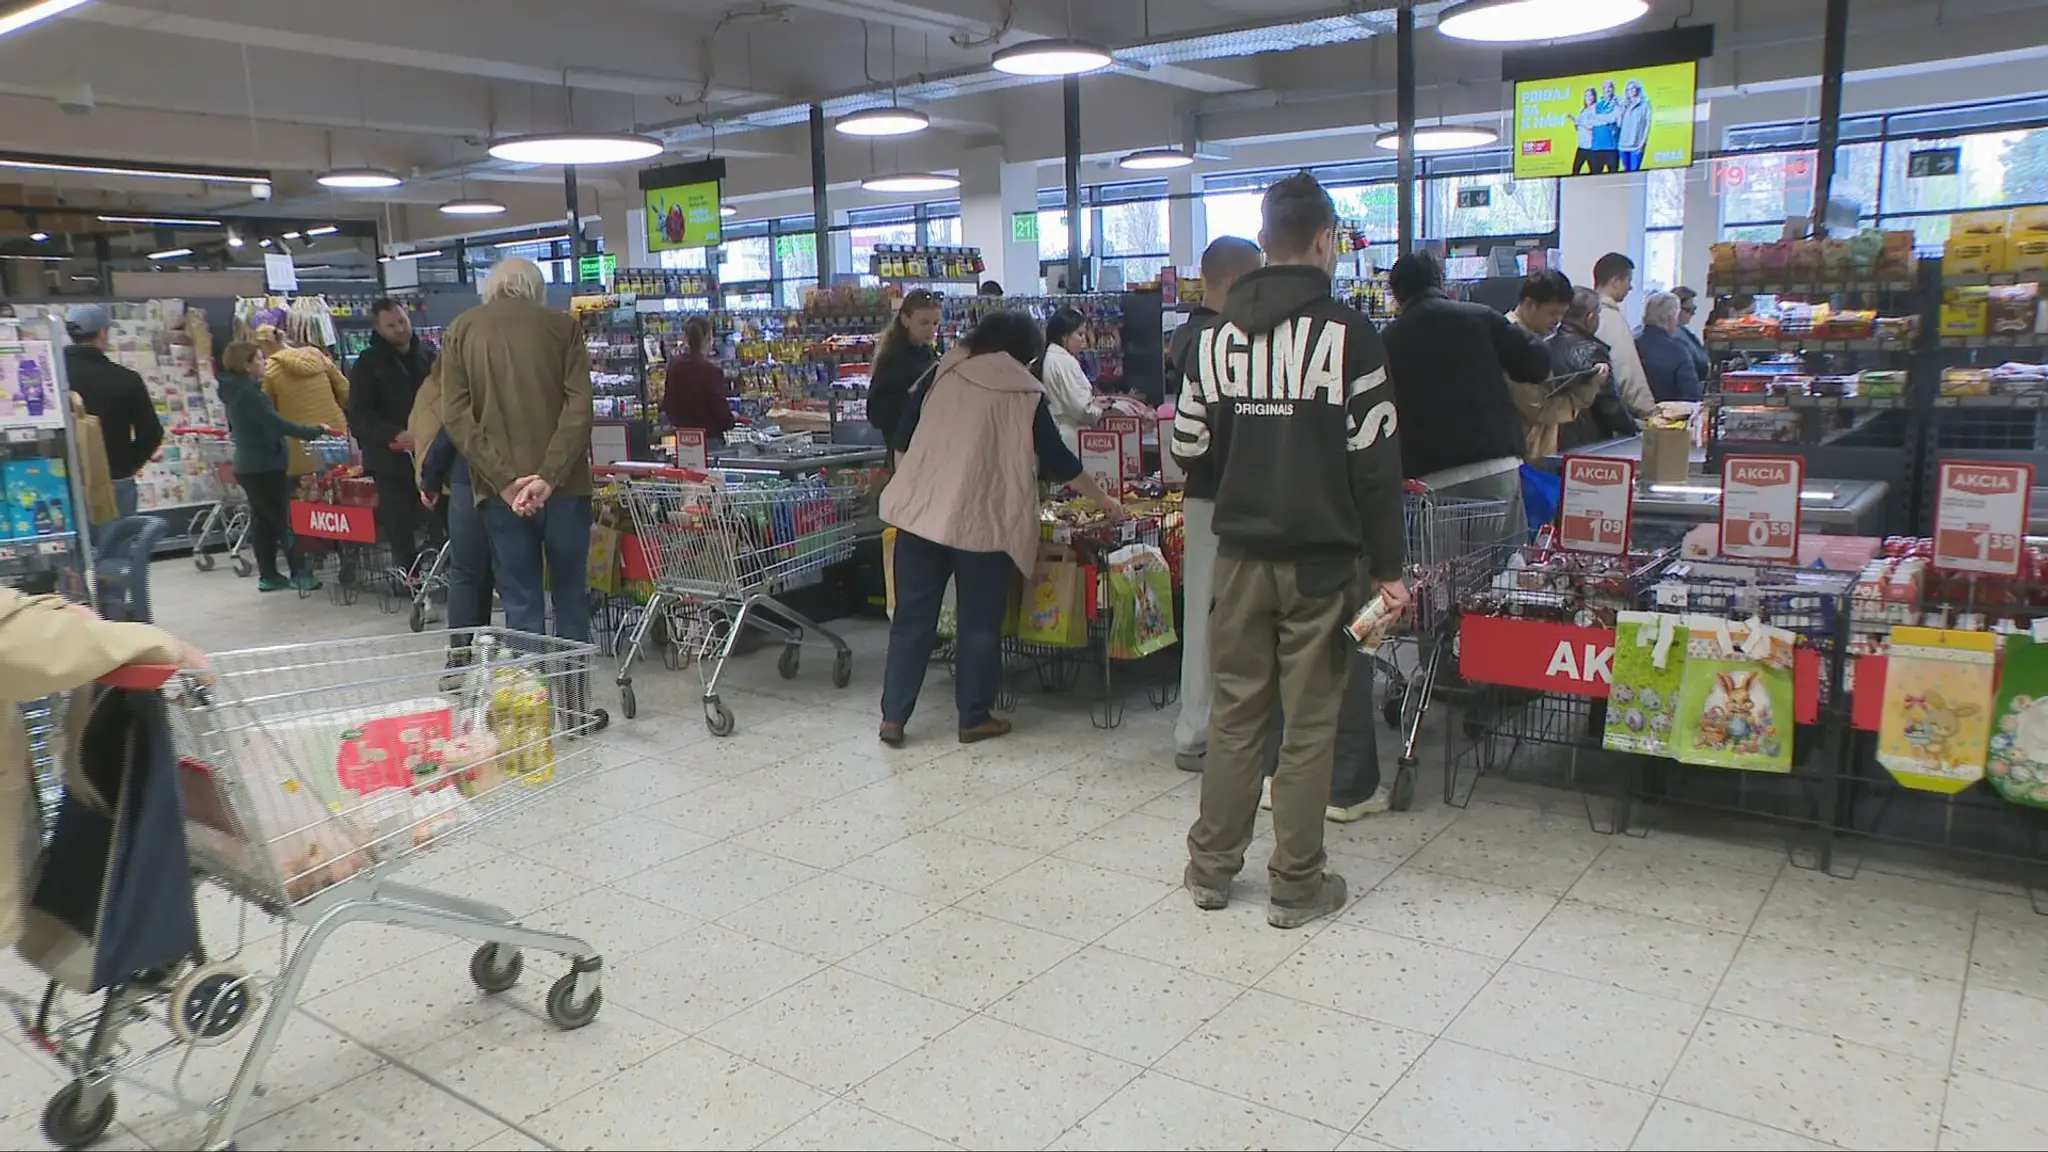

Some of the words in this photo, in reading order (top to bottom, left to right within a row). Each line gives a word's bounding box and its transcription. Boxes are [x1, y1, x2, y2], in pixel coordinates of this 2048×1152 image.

[1086, 439, 1112, 449] AKCIA
[1575, 467, 1618, 480] AKCIA
[1736, 467, 1785, 480] AKCIA
[1952, 474, 2010, 489] AKCIA
[310, 510, 350, 533] AKCIA
